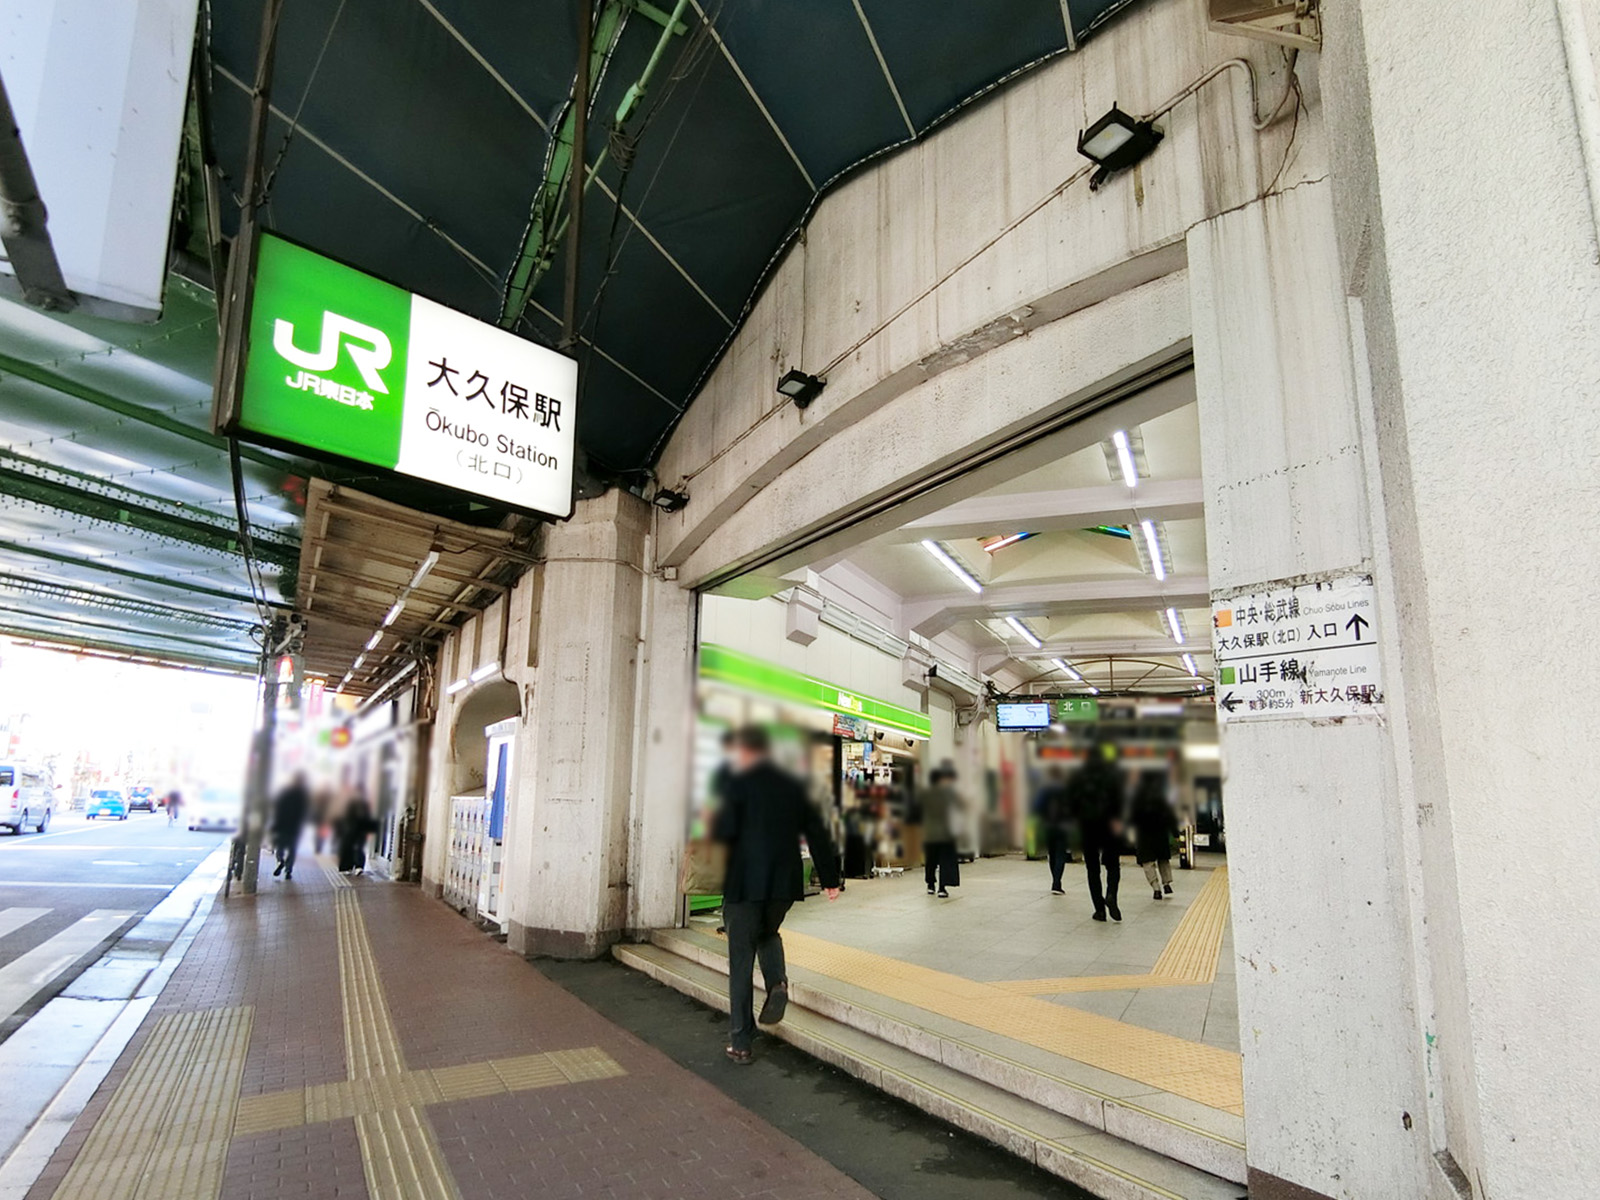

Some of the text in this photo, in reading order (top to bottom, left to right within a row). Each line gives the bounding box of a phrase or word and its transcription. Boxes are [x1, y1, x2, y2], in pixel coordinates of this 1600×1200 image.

[273, 310, 392, 395] JR
[285, 370, 375, 411] JR東日本
[426, 357, 562, 433] 大久保駅
[425, 406, 559, 471] Ōkubo Station
[1347, 599, 1369, 609] Lines
[1307, 622, 1337, 641] 入口
[1239, 658, 1367, 685] 山手線 Yamanote Line
[1256, 688, 1286, 699] 300m
[1300, 684, 1377, 706] 新大久保駅
